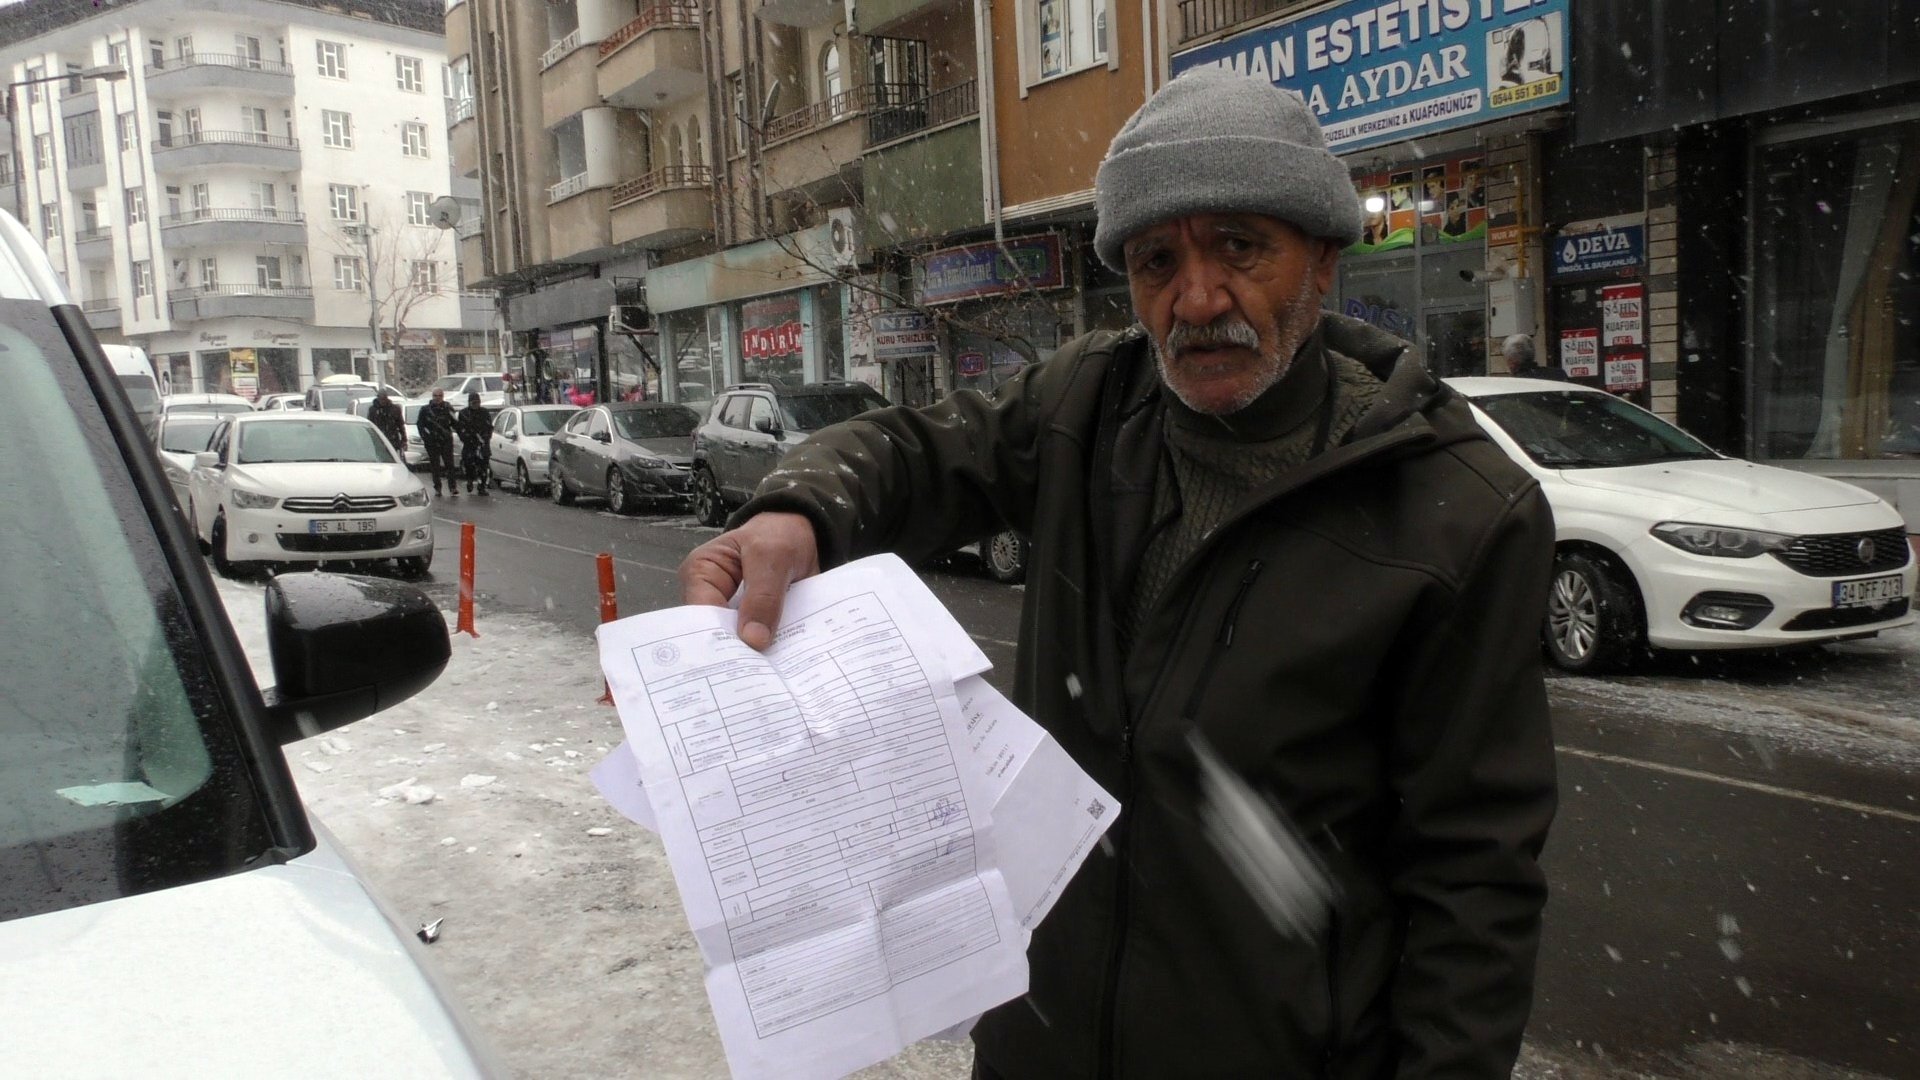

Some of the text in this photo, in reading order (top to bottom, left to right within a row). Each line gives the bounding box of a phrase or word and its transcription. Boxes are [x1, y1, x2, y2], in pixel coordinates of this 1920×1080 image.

[1337, 44, 1470, 111] AYDAR
[1578, 232, 1631, 255] DEVA
[876, 334, 895, 345] KURU
[316, 521, 374, 532] 65 AL 195
[1841, 584, 1855, 601] 34
[1858, 581, 1879, 600] DFF
